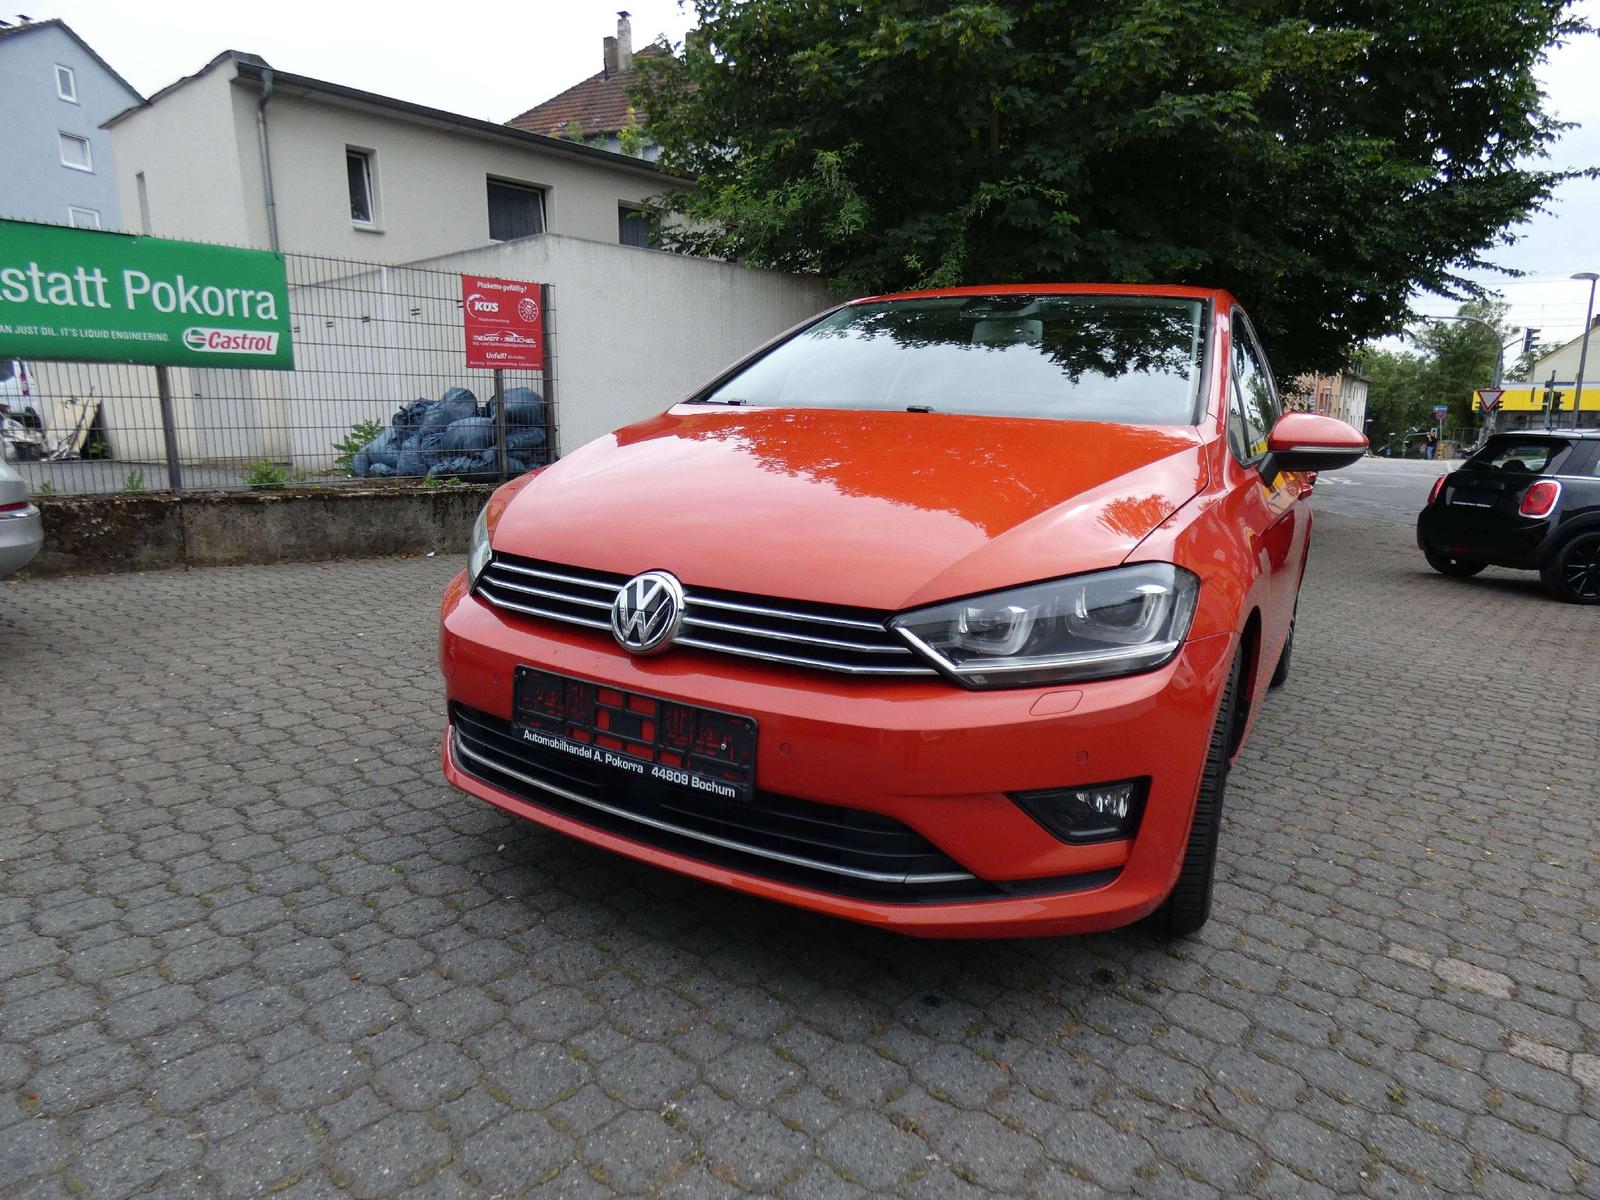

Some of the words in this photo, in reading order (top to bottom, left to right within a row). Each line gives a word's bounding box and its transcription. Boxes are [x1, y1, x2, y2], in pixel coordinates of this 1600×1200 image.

[0, 261, 111, 309] statt
[123, 269, 278, 320] Pokorra
[15, 325, 39, 336] JUST
[79, 329, 110, 339] LIQUID
[208, 331, 273, 351] Castrol
[523, 729, 592, 760] Automobilhandel
[593, 749, 603, 763] A.
[605, 753, 644, 774] Pokorra
[651, 766, 689, 785] 44809
[691, 777, 736, 799] Bochum
